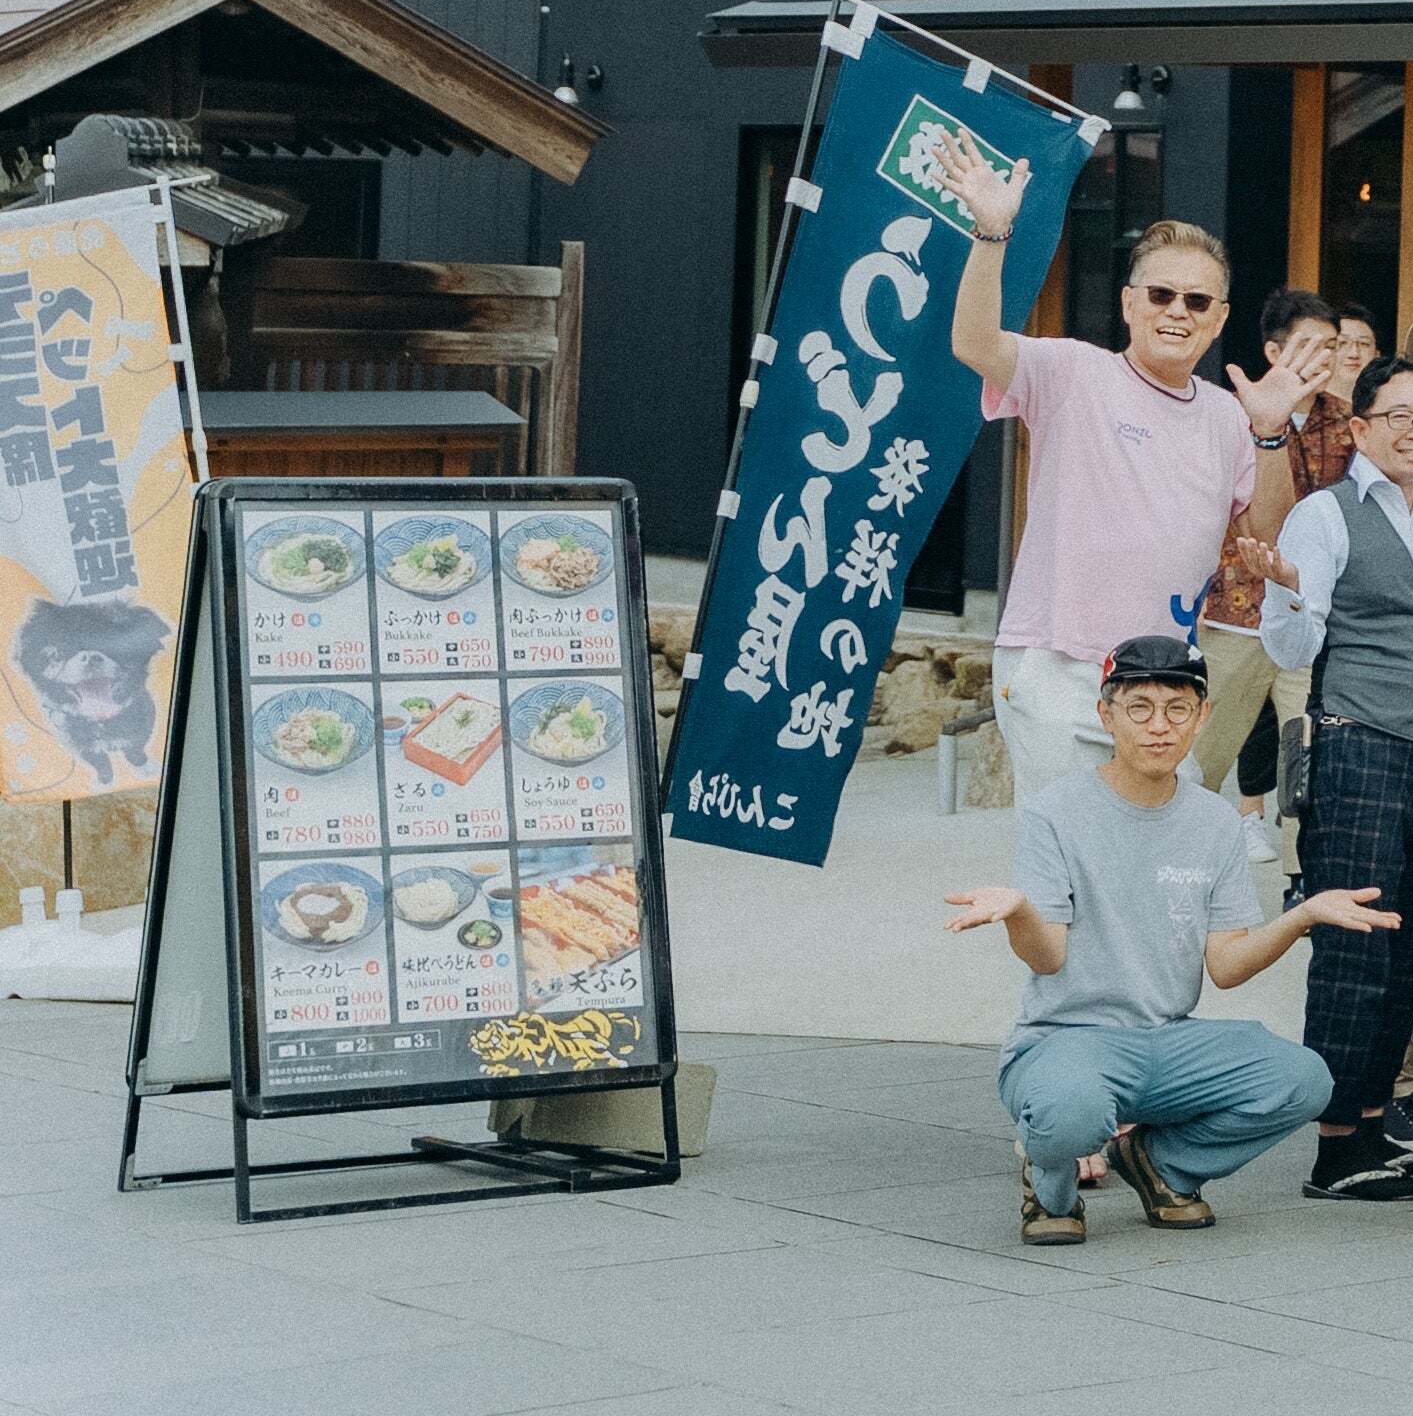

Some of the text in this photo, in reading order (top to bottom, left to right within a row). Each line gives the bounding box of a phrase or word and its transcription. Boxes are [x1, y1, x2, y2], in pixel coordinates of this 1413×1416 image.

[254, 612, 285, 628] かけ
[384, 610, 441, 626] ぶっかけ
[256, 632, 283, 643] Kake
[384, 630, 432, 641] Bukkake
[511, 626, 583, 638] Beef Bukkake
[334, 641, 364, 654] 590
[460, 638, 491, 653] 650
[583, 634, 614, 649] 890
[275, 651, 312, 668] 490
[403, 648, 439, 665] 550
[461, 654, 492, 668] 750
[529, 645, 565, 662] 790
[585, 651, 615, 664] 990
[335, 657, 366, 671] 690
[522, 776, 570, 794] しょうゆ
[524, 795, 577, 808] Soy Sauce
[266, 805, 291, 818] Beef
[470, 808, 501, 823] 650
[595, 803, 624, 817] 650
[342, 813, 375, 828] 880
[540, 815, 576, 831] 550
[596, 818, 625, 833] 750
[282, 825, 321, 842] 780
[413, 820, 449, 837] 550
[472, 824, 502, 839] 750
[344, 830, 376, 845] 980
[270, 962, 362, 982] キーマカレー
[273, 986, 312, 997] Keema
[481, 981, 513, 996] 800
[351, 990, 383, 1004] 900
[422, 994, 459, 1012] 700
[576, 996, 626, 1009] Tempura
[291, 1004, 329, 1021] 800
[482, 998, 513, 1013] 900
[353, 1008, 386, 1022] 1000
